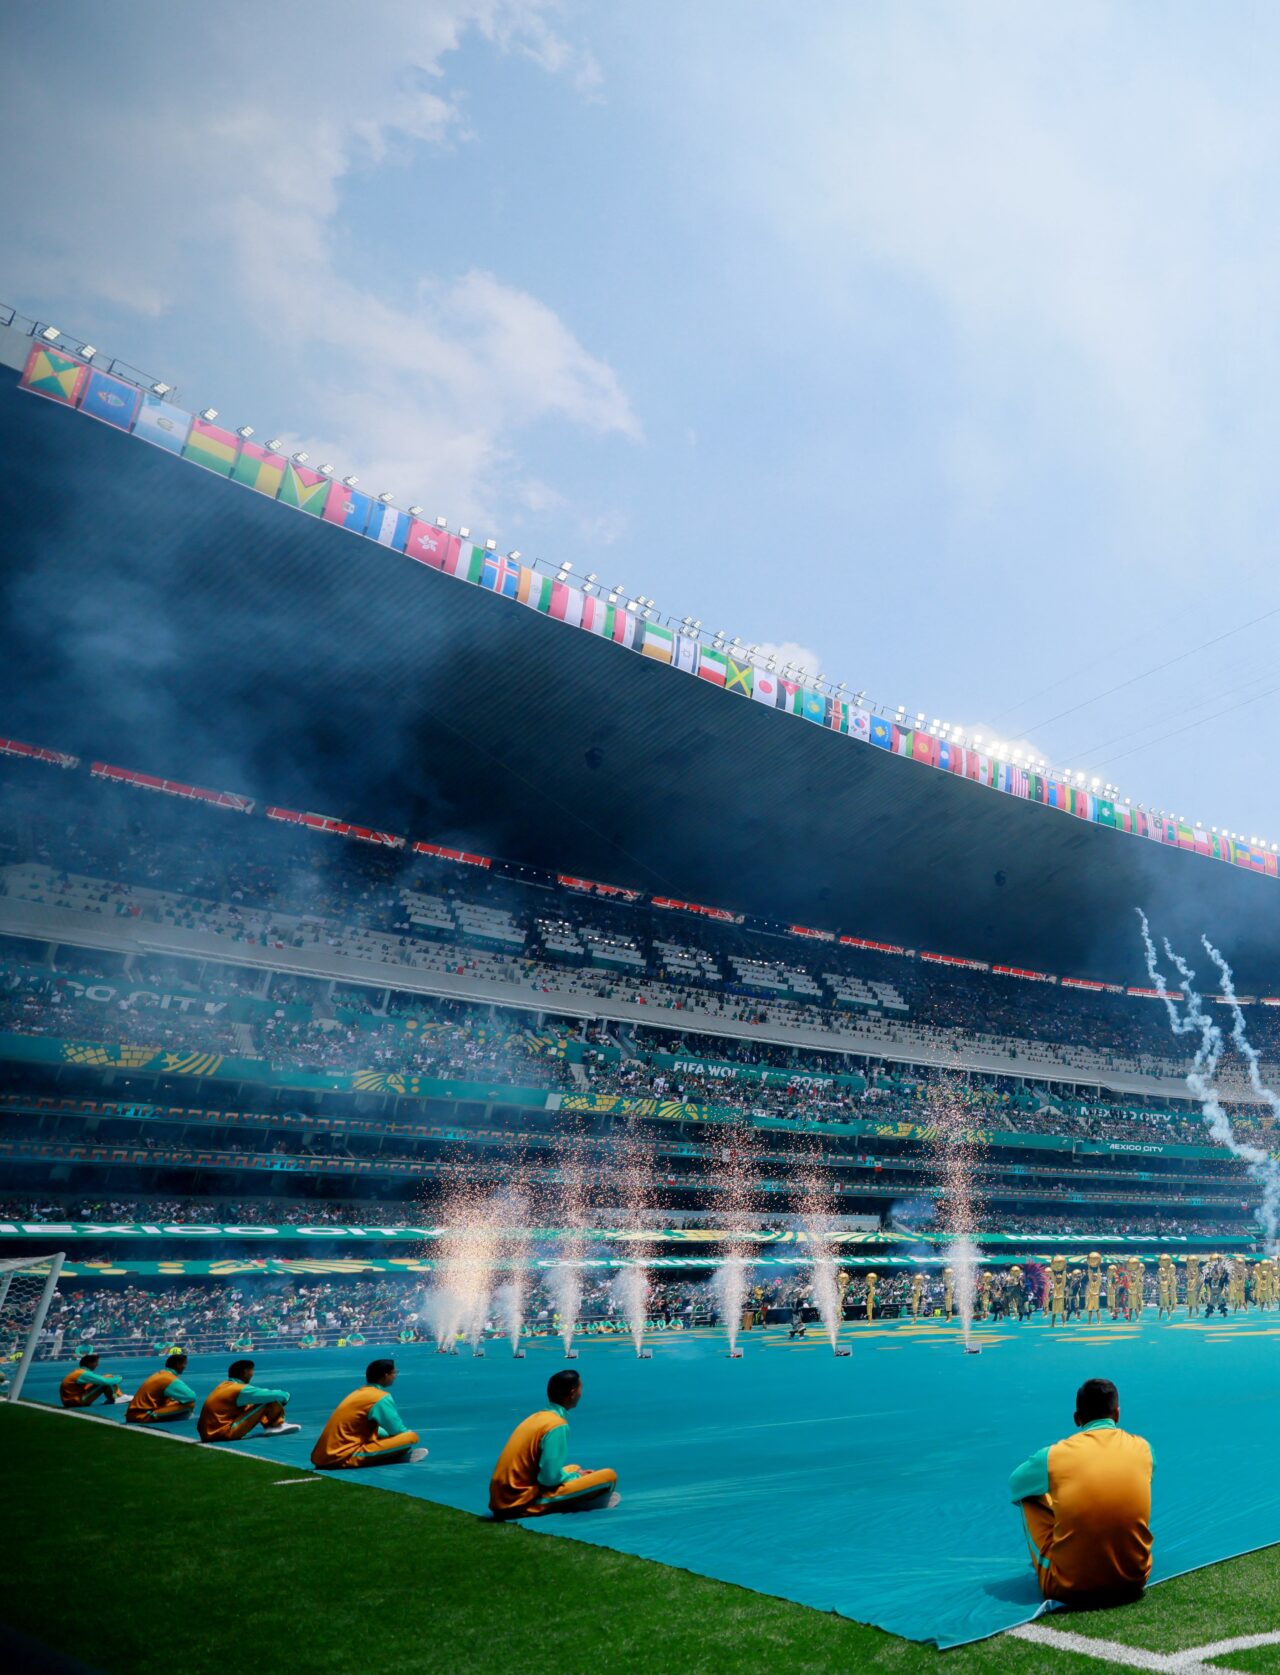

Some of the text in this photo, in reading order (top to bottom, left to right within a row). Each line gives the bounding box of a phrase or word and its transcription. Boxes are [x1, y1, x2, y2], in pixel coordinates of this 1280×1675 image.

[673, 1061, 705, 1074] FIFA
[1142, 1145, 1164, 1153] CITY
[296, 1226, 450, 1236] CITY
